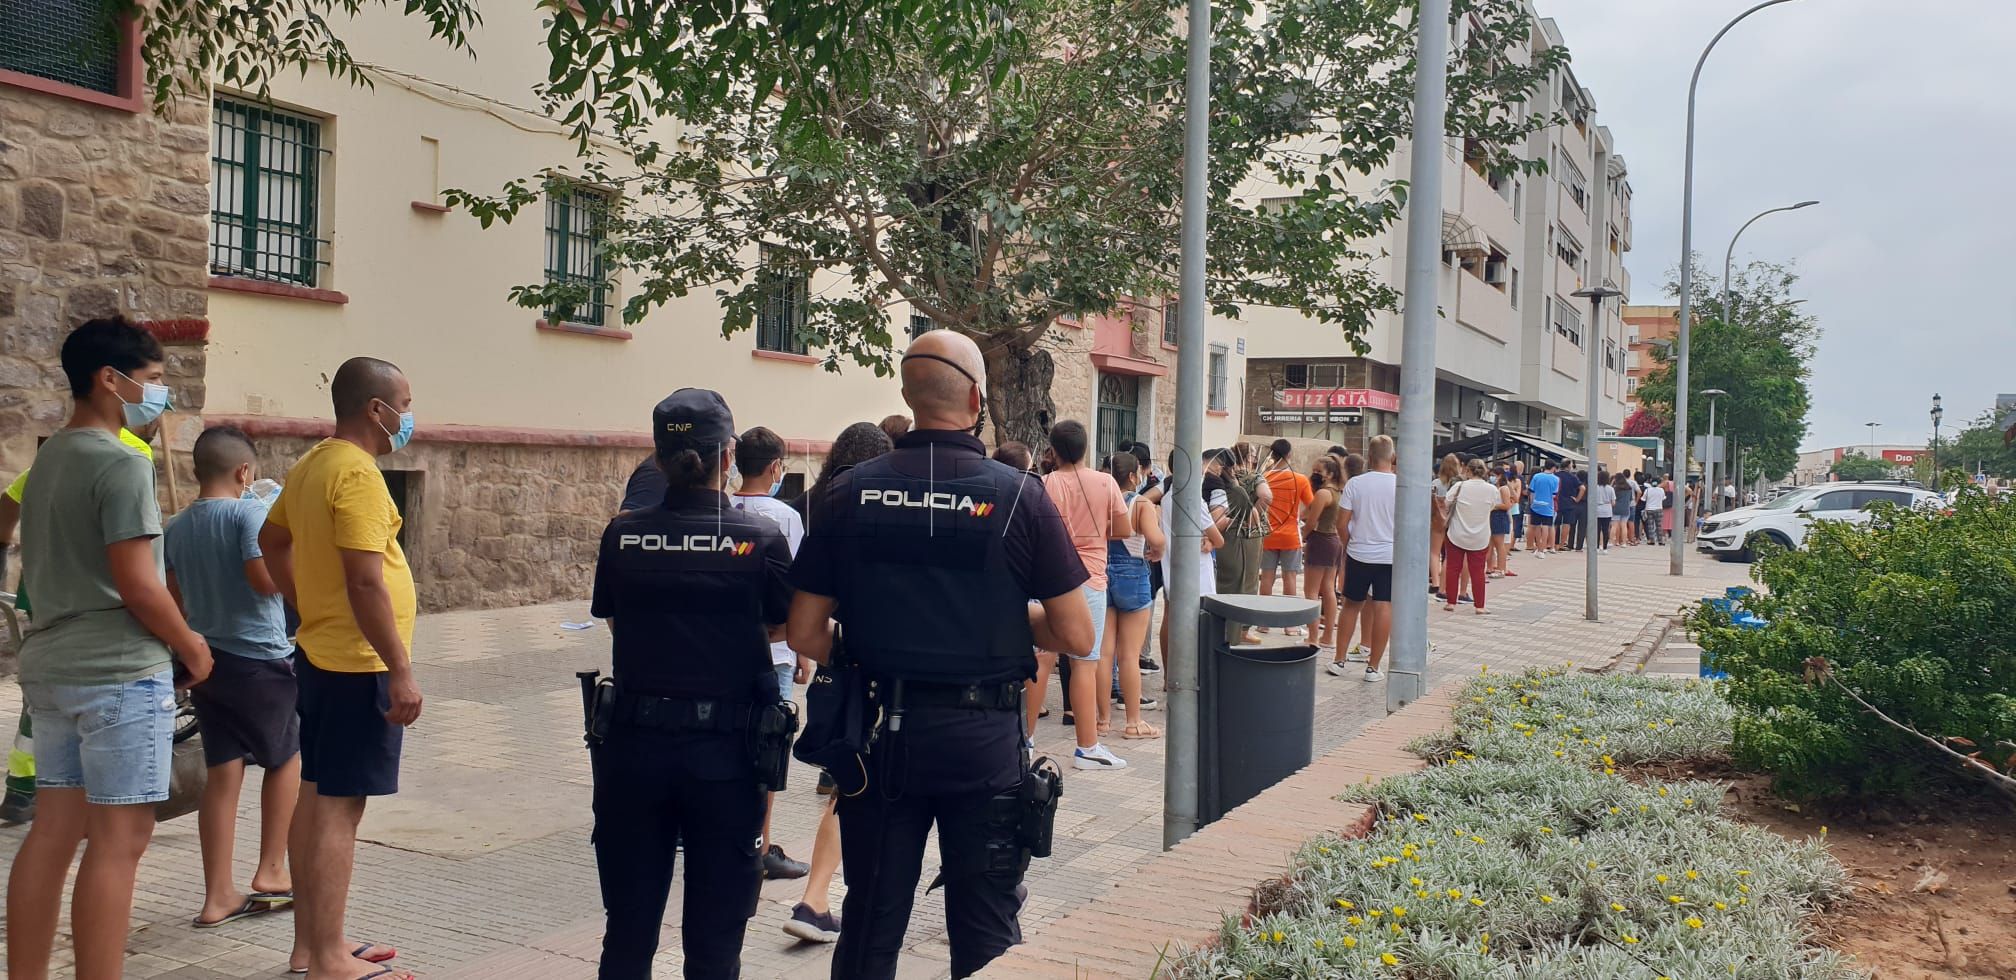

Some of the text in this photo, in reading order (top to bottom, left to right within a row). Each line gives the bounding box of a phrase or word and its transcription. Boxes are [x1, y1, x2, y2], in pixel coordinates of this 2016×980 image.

[666, 422, 693, 433] CNP
[860, 488, 978, 512] POLICIA
[619, 534, 738, 552] POLICIA
